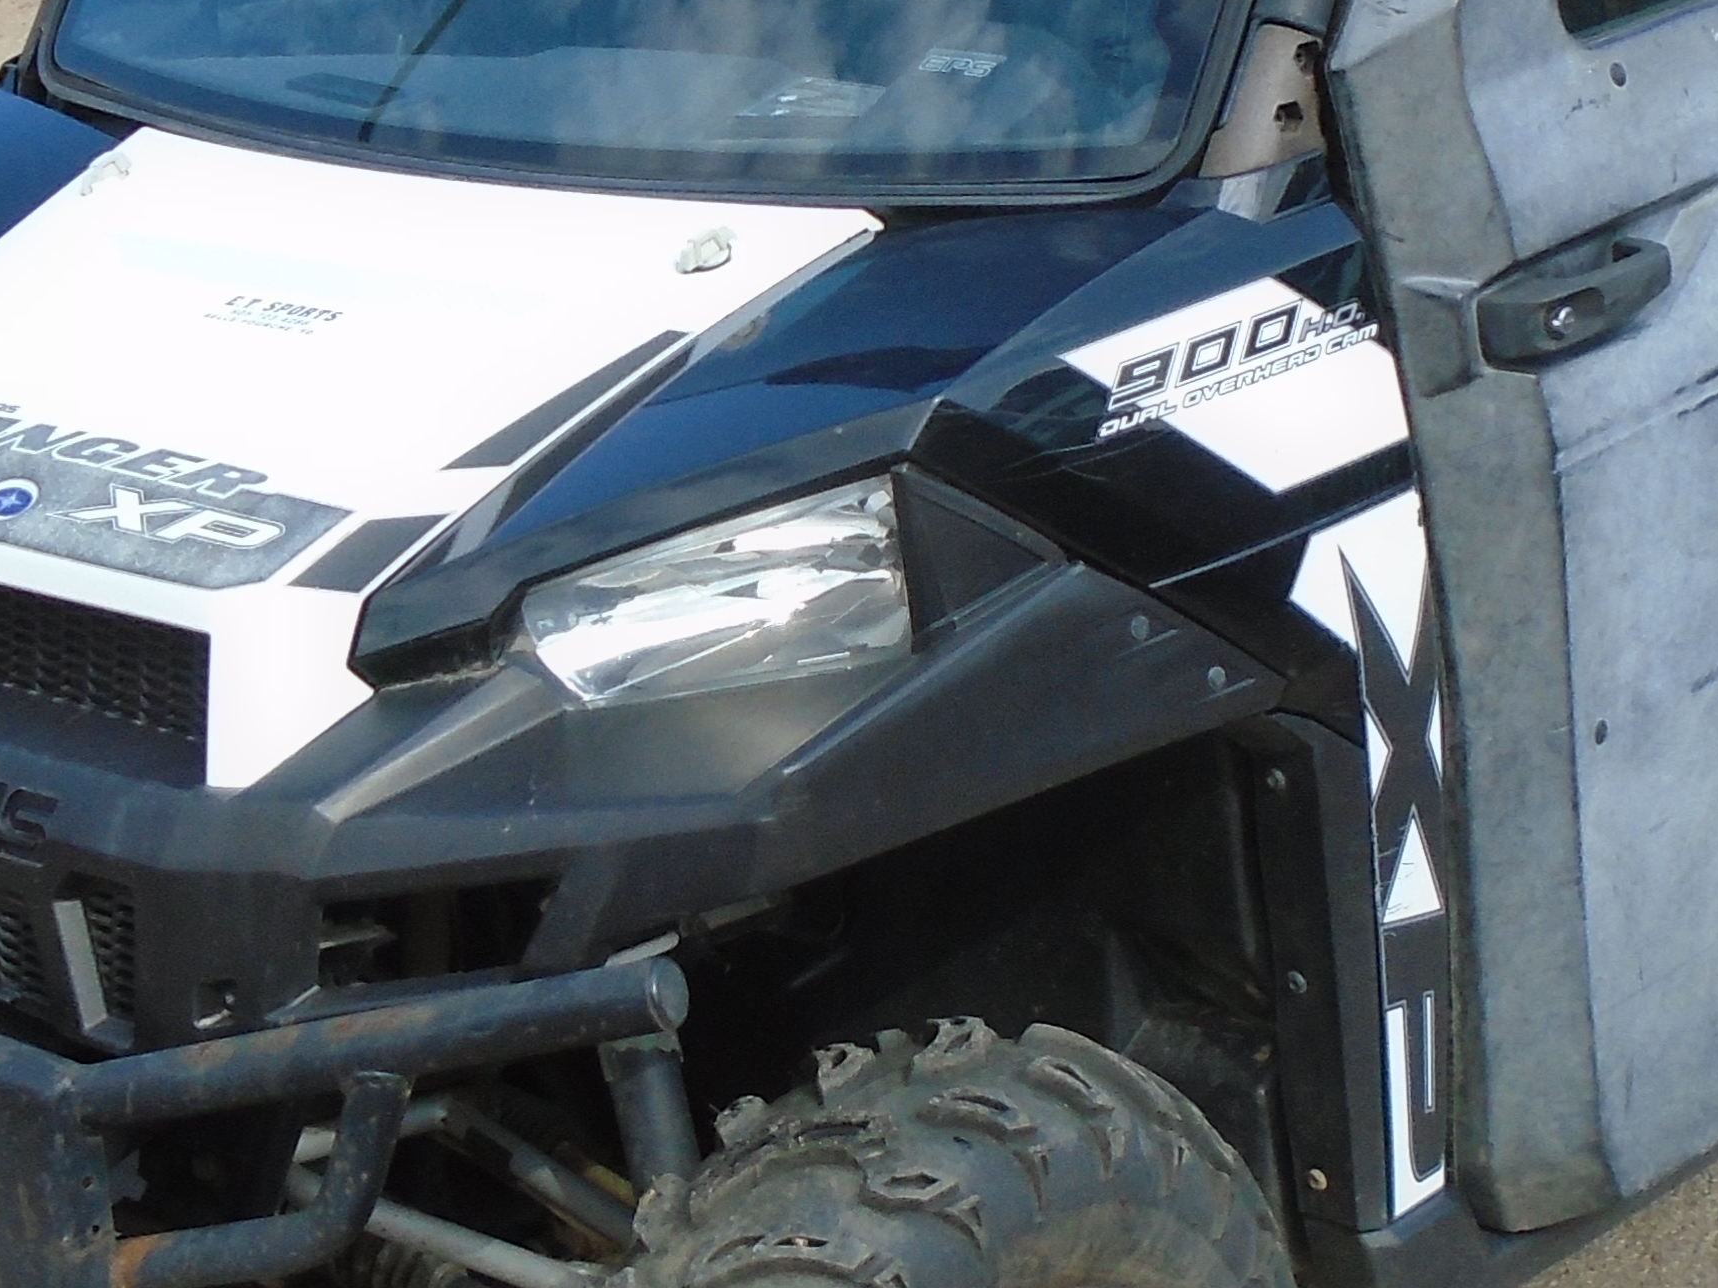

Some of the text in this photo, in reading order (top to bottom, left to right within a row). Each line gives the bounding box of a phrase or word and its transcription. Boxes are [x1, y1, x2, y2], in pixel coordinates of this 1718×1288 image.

[918, 55, 997, 78] EPS
[262, 301, 344, 322] SPORTS
[1095, 321, 1380, 442] DUAL OVERHEAD CAM
[1107, 298, 1303, 412] 900
[46, 482, 286, 550] XP
